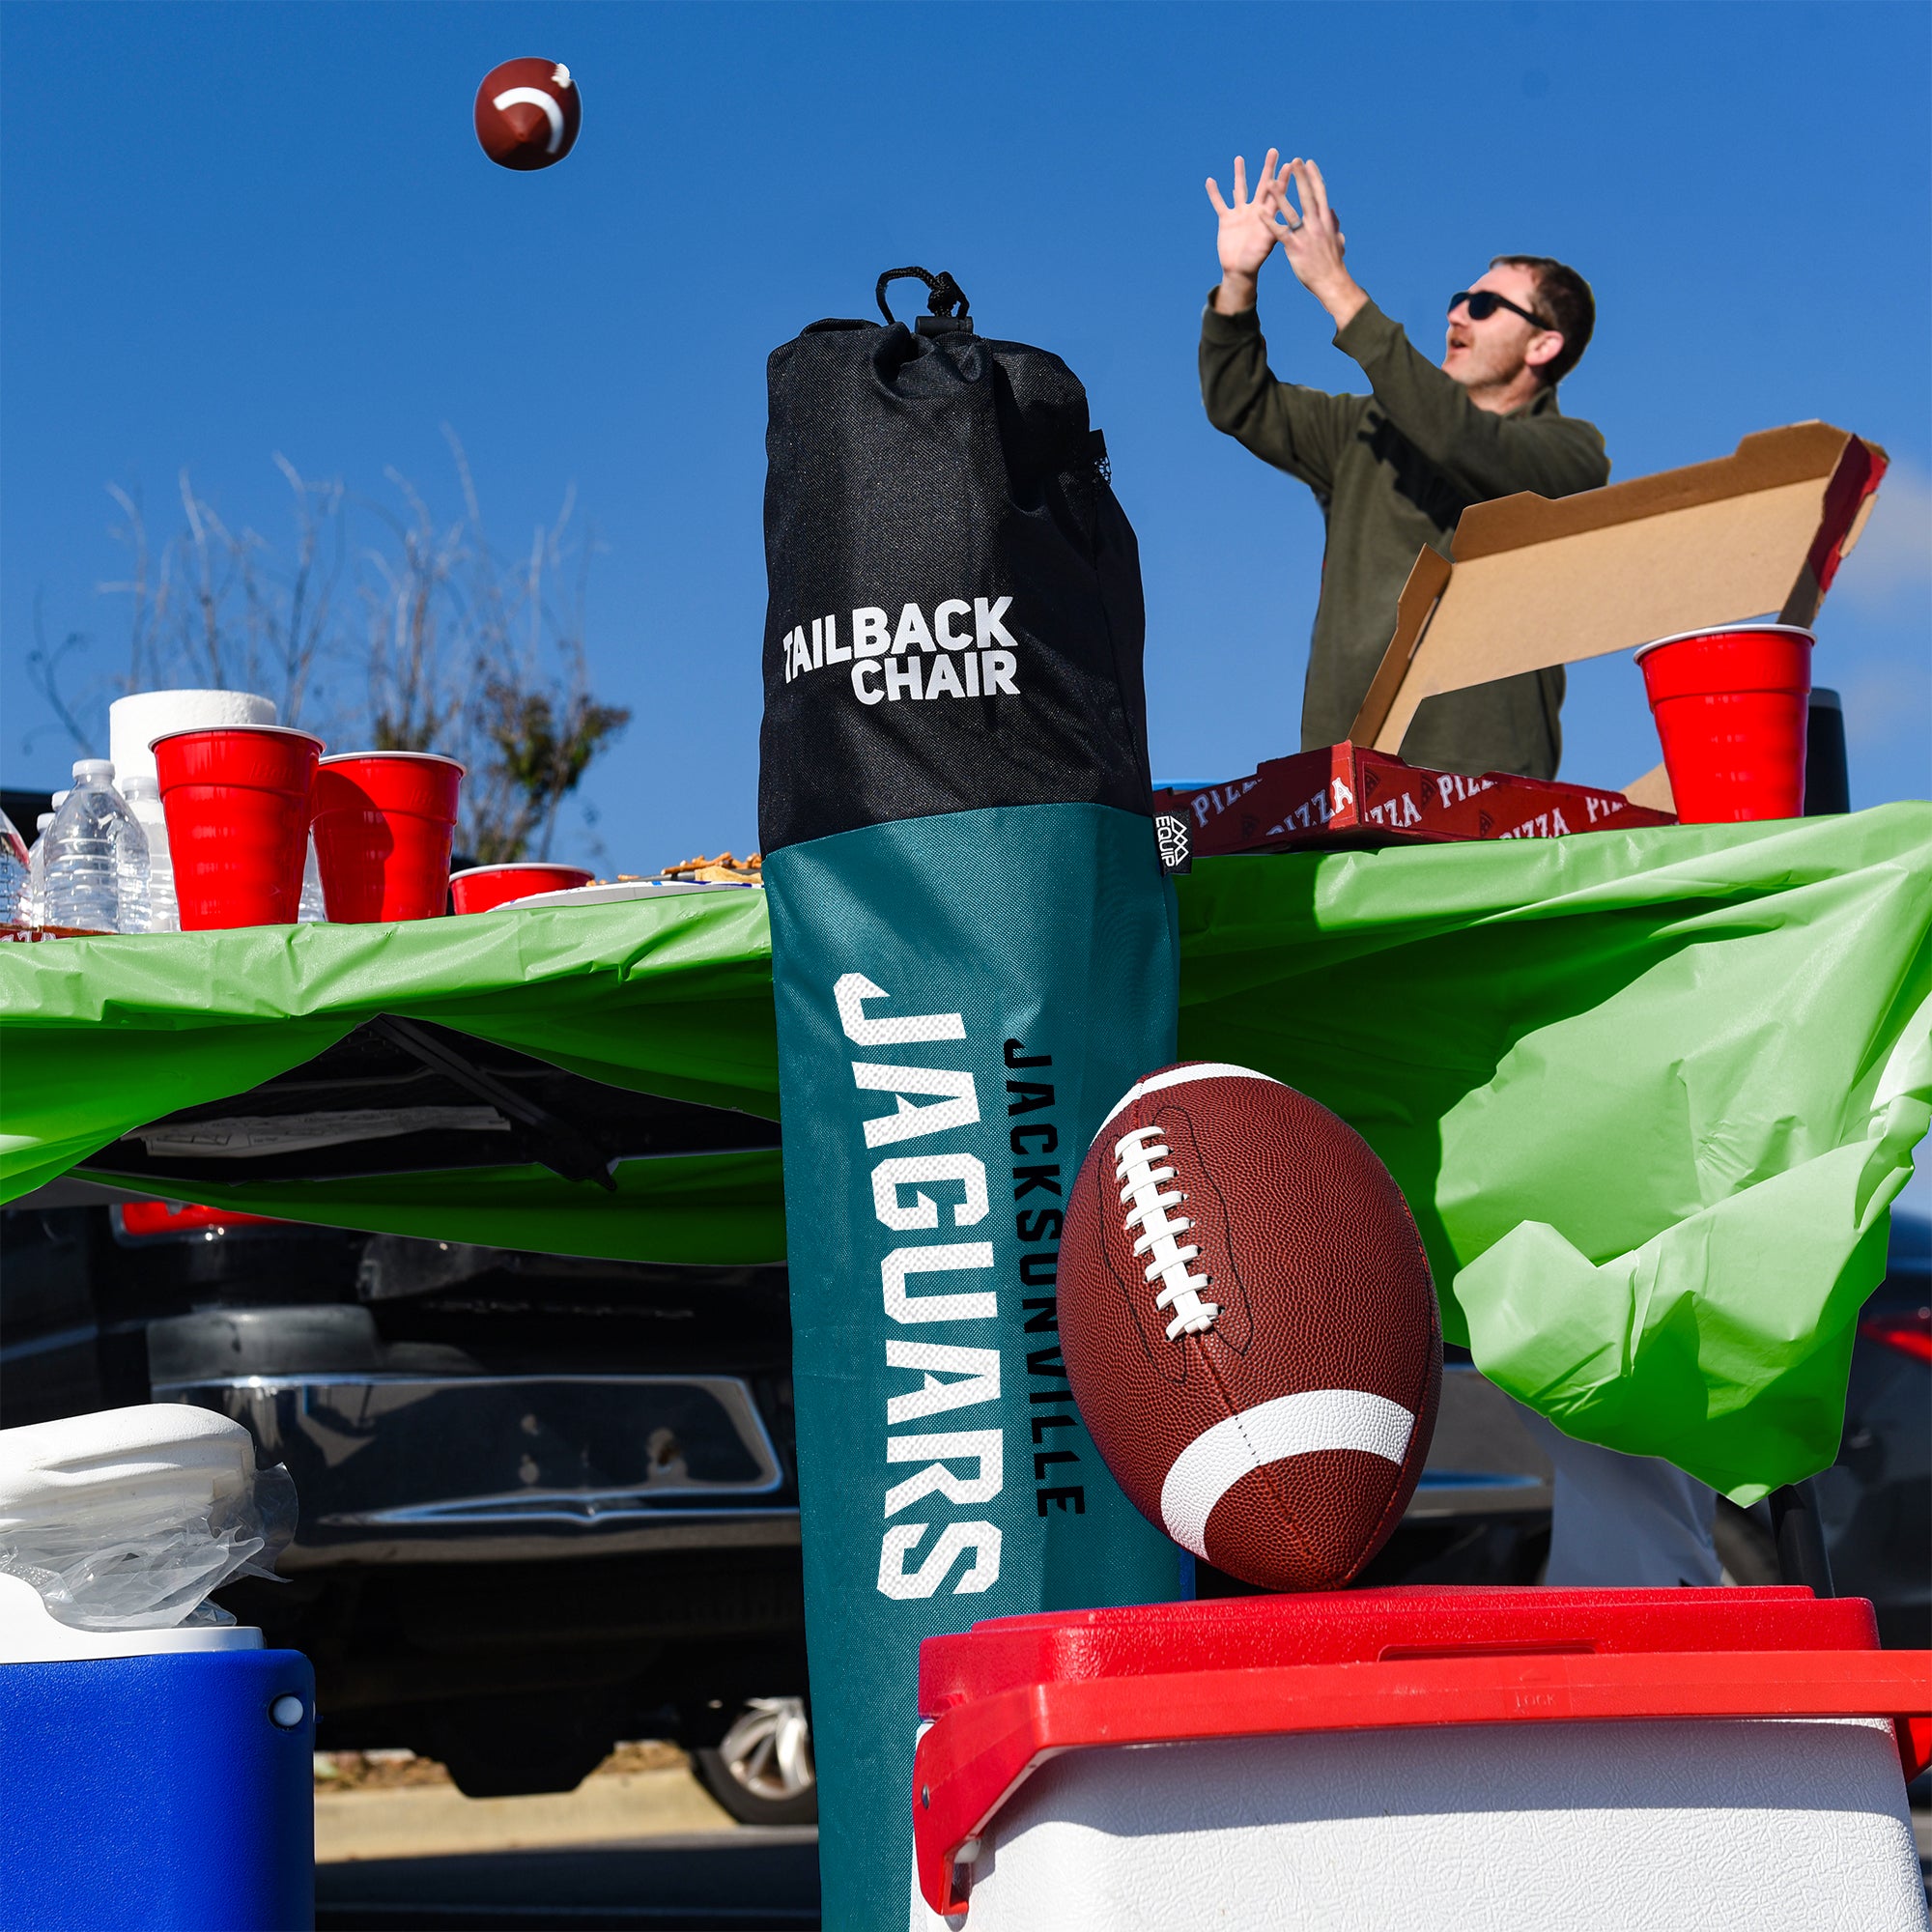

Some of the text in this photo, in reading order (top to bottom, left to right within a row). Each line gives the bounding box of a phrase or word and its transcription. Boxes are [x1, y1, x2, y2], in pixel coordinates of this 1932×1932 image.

[782, 596, 1018, 684] TAILBACK
[851, 650, 1021, 705] CHAIR
[1155, 815, 1176, 867] EQUIP
[833, 972, 1003, 1601] JAGUARS
[1004, 1038, 1086, 1518] JACKSONVILLE
